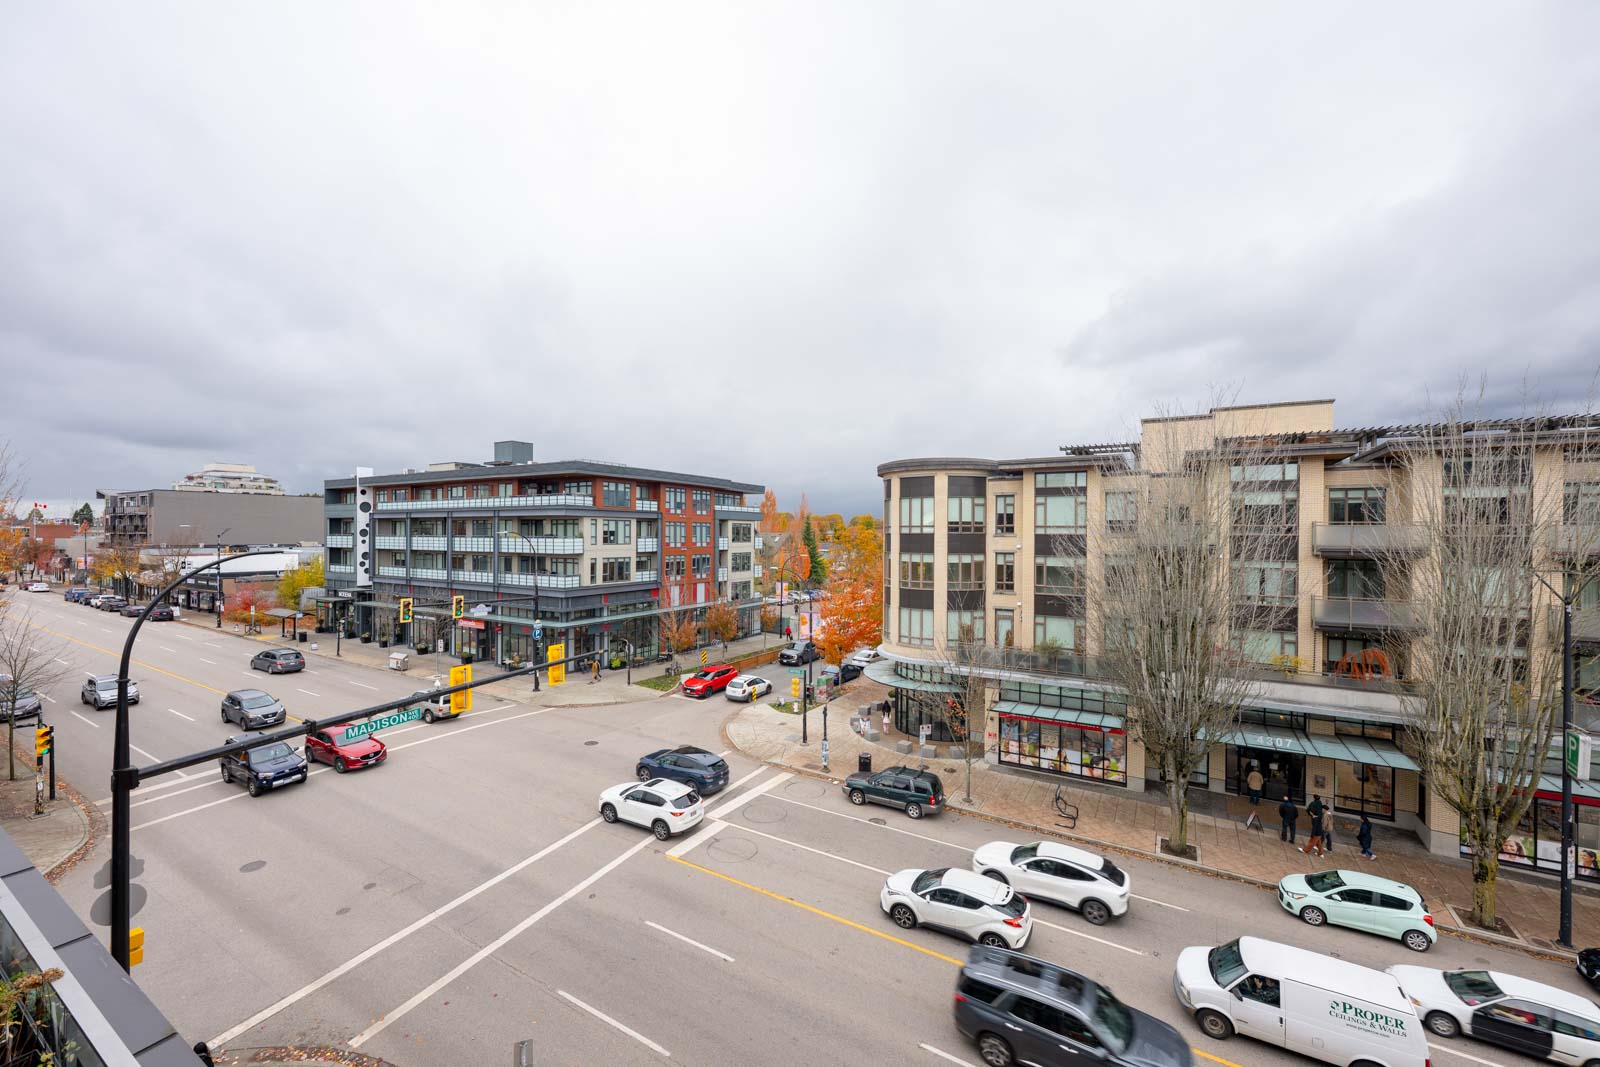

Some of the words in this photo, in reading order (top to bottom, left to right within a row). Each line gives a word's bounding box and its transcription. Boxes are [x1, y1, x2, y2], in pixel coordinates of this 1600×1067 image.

[348, 712, 408, 738] MADISON
[1257, 735, 1292, 748] 4307
[1569, 735, 1577, 760] P
[1342, 1001, 1406, 1030] PROPER
[1369, 1021, 1376, 1029] &
[1378, 1023, 1407, 1038] WALLS
